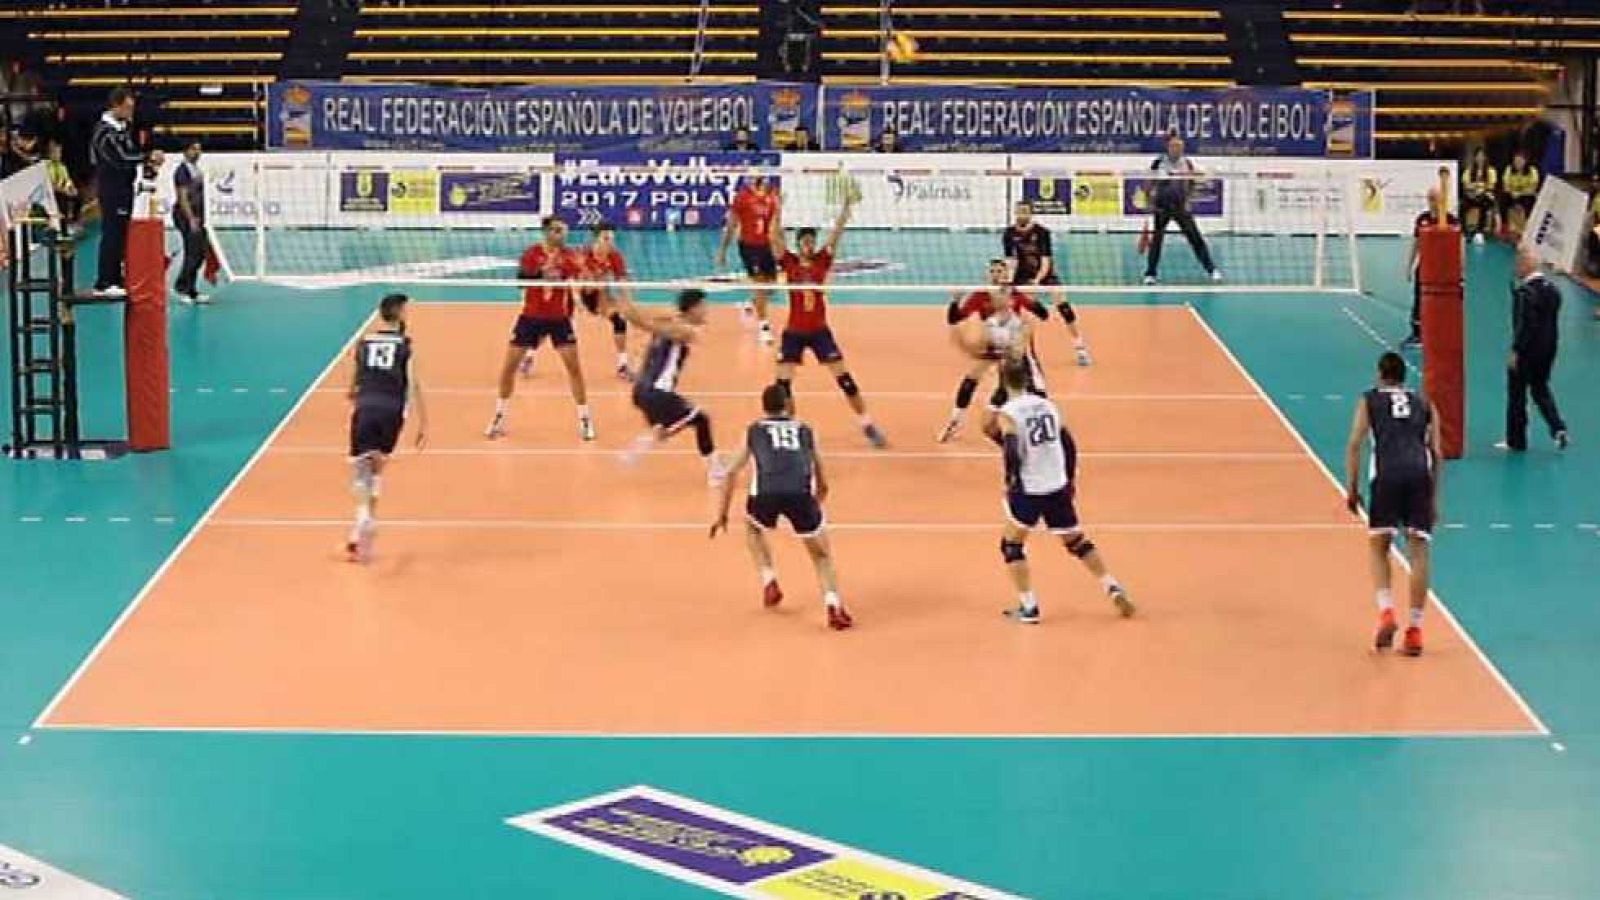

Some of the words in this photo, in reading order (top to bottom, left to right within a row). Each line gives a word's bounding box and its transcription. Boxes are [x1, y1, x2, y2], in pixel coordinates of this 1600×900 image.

[323, 97, 375, 132] REAL
[381, 92, 509, 136] FEDERACIÓN
[516, 91, 622, 135] ESPAÑOLA
[627, 99, 656, 135] DE
[659, 96, 759, 134] VOLEIBOL
[883, 100, 934, 135] REAL
[1076, 91, 1180, 136] ESPAÑOLA
[1186, 103, 1213, 138] DE
[1220, 103, 1315, 139] VOLEIBOL
[560, 190, 638, 207] 2017
[652, 190, 736, 207] POLA
[905, 180, 972, 200] Palmas
[367, 341, 397, 370] 13
[1024, 414, 1057, 447] 20
